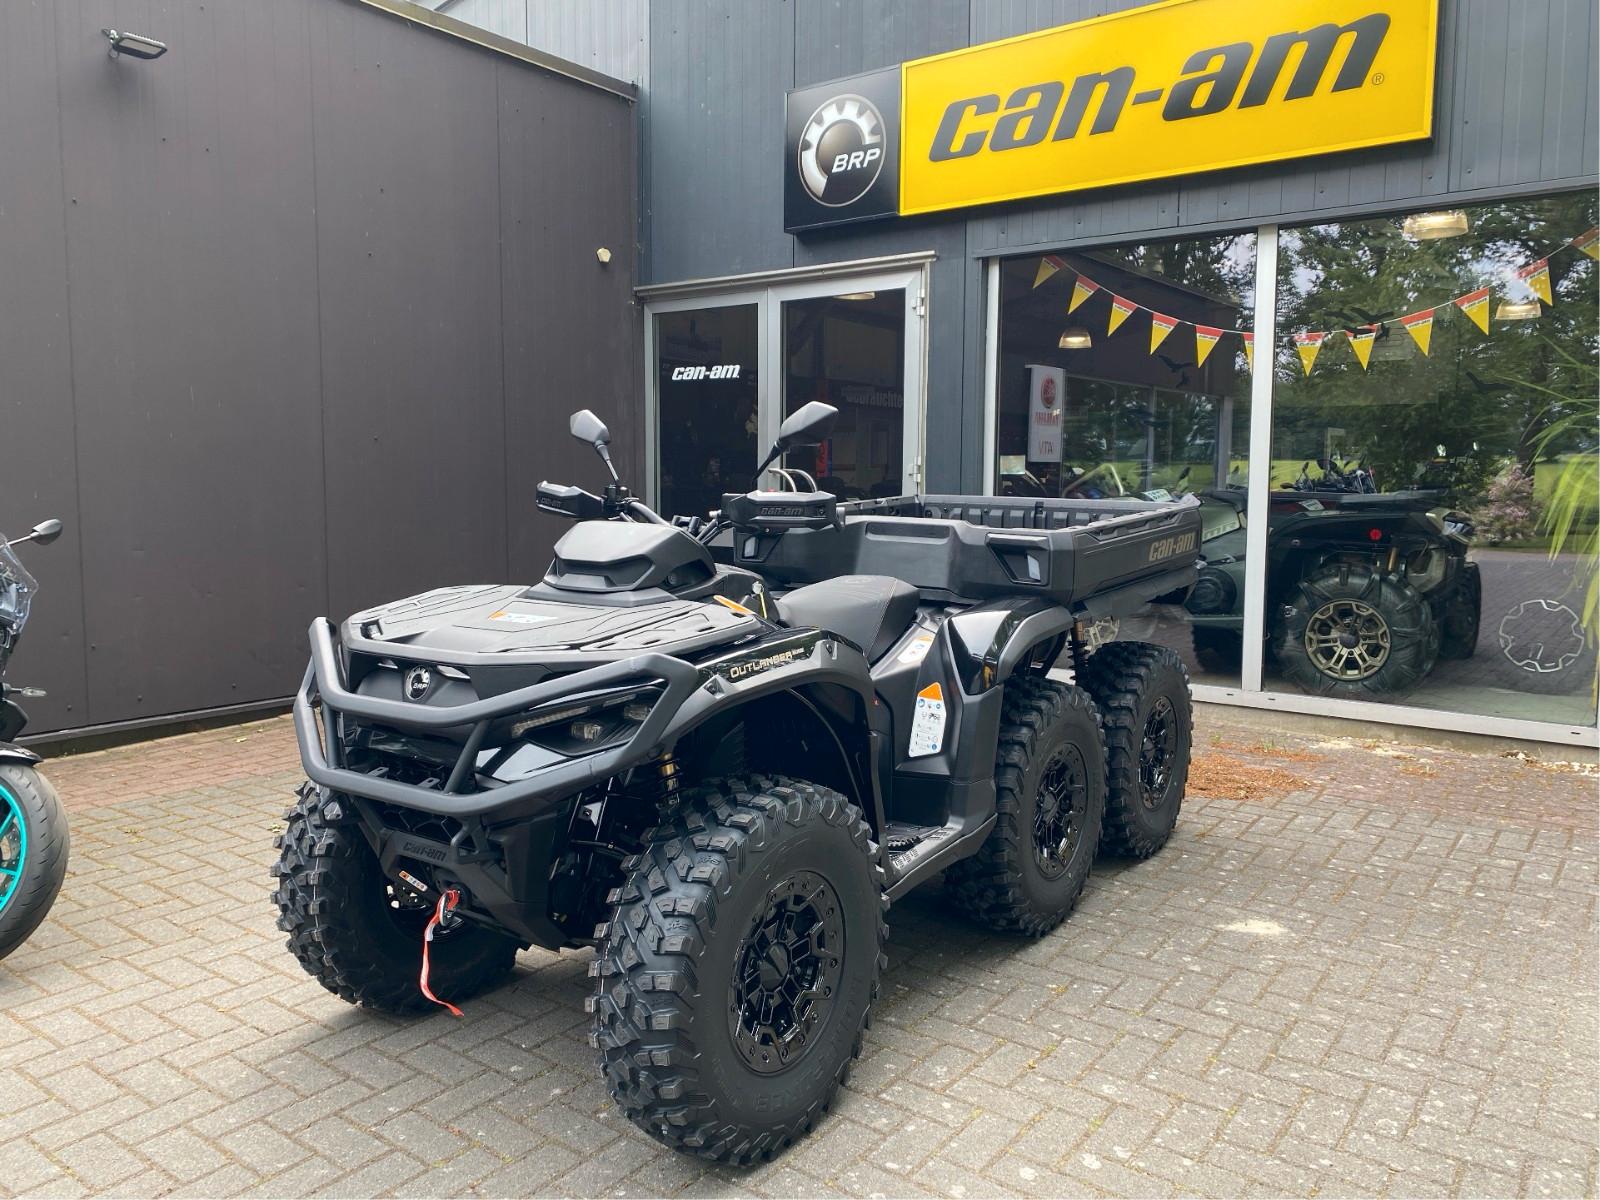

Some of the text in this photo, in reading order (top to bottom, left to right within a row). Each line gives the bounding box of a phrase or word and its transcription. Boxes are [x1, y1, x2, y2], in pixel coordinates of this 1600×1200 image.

[929, 13, 1391, 162] can-am
[832, 148, 880, 173] BRP
[671, 364, 741, 381] can-am
[1149, 531, 1196, 562] can-am
[729, 651, 793, 678] OUTLANDER
